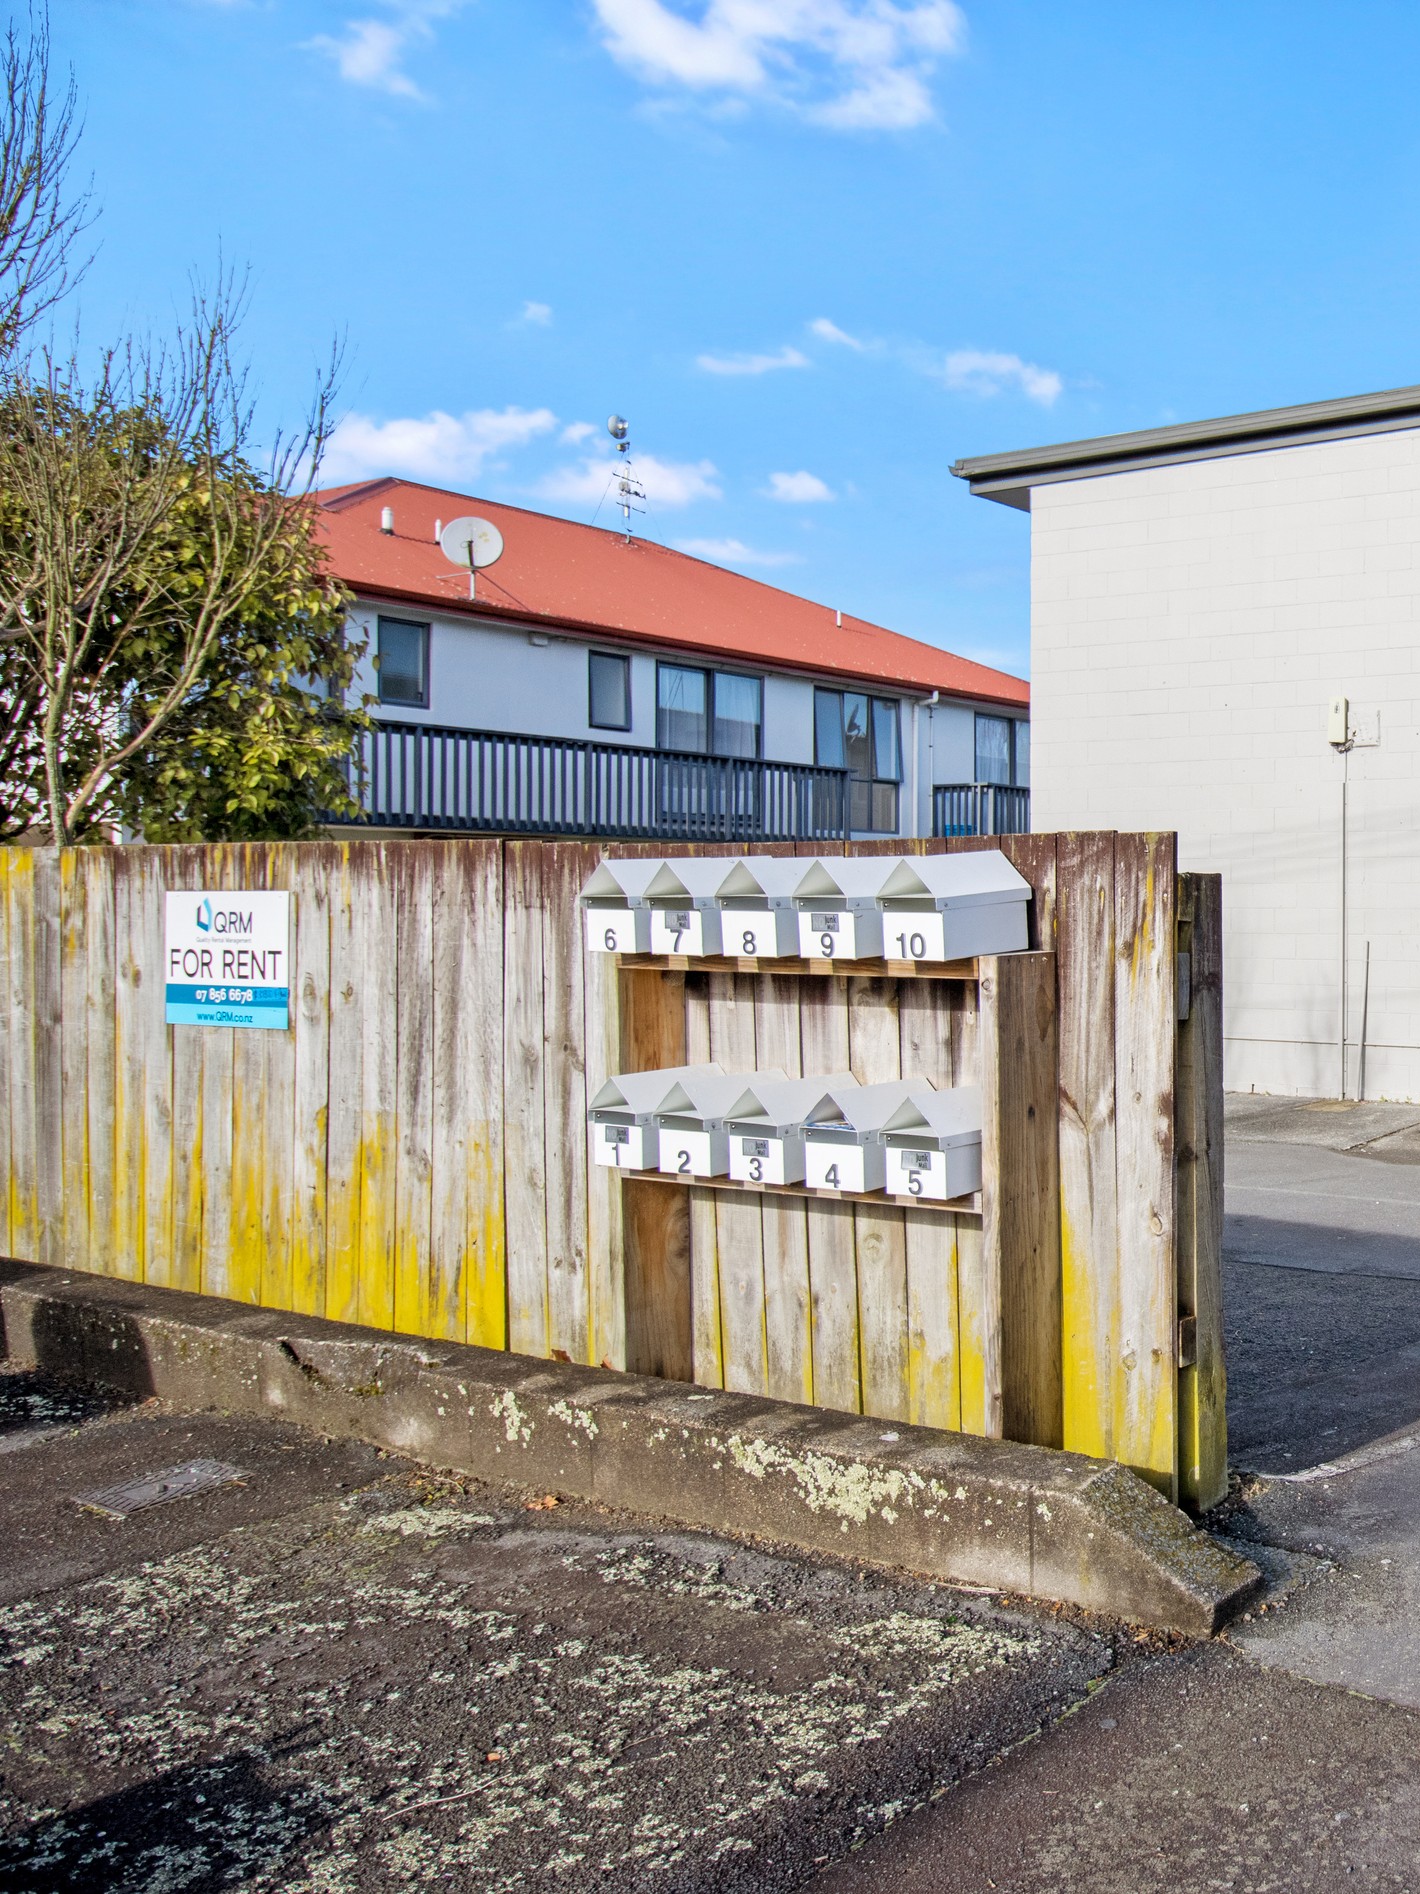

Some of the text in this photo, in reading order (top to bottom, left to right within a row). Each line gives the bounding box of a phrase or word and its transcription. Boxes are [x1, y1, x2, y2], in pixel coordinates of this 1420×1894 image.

[214, 911, 253, 934] QRM
[825, 915, 837, 924] Junk
[604, 928, 617, 951] 6
[670, 928, 684, 953] 7
[742, 930, 756, 955] 8
[820, 932, 835, 958] 9
[896, 932, 927, 959] 10
[171, 948, 283, 981] FOR RENT
[195, 989, 208, 1003] 07
[208, 987, 227, 1004] 856
[228, 988, 254, 1005] 6678
[196, 1010, 254, 1023] www.QRM.co.nz
[611, 1143, 620, 1166] 1
[677, 1150, 692, 1174] 2
[916, 1153, 929, 1163] Junk
[749, 1157, 763, 1182] 3
[825, 1163, 841, 1189] 4
[908, 1169, 923, 1195] 5
